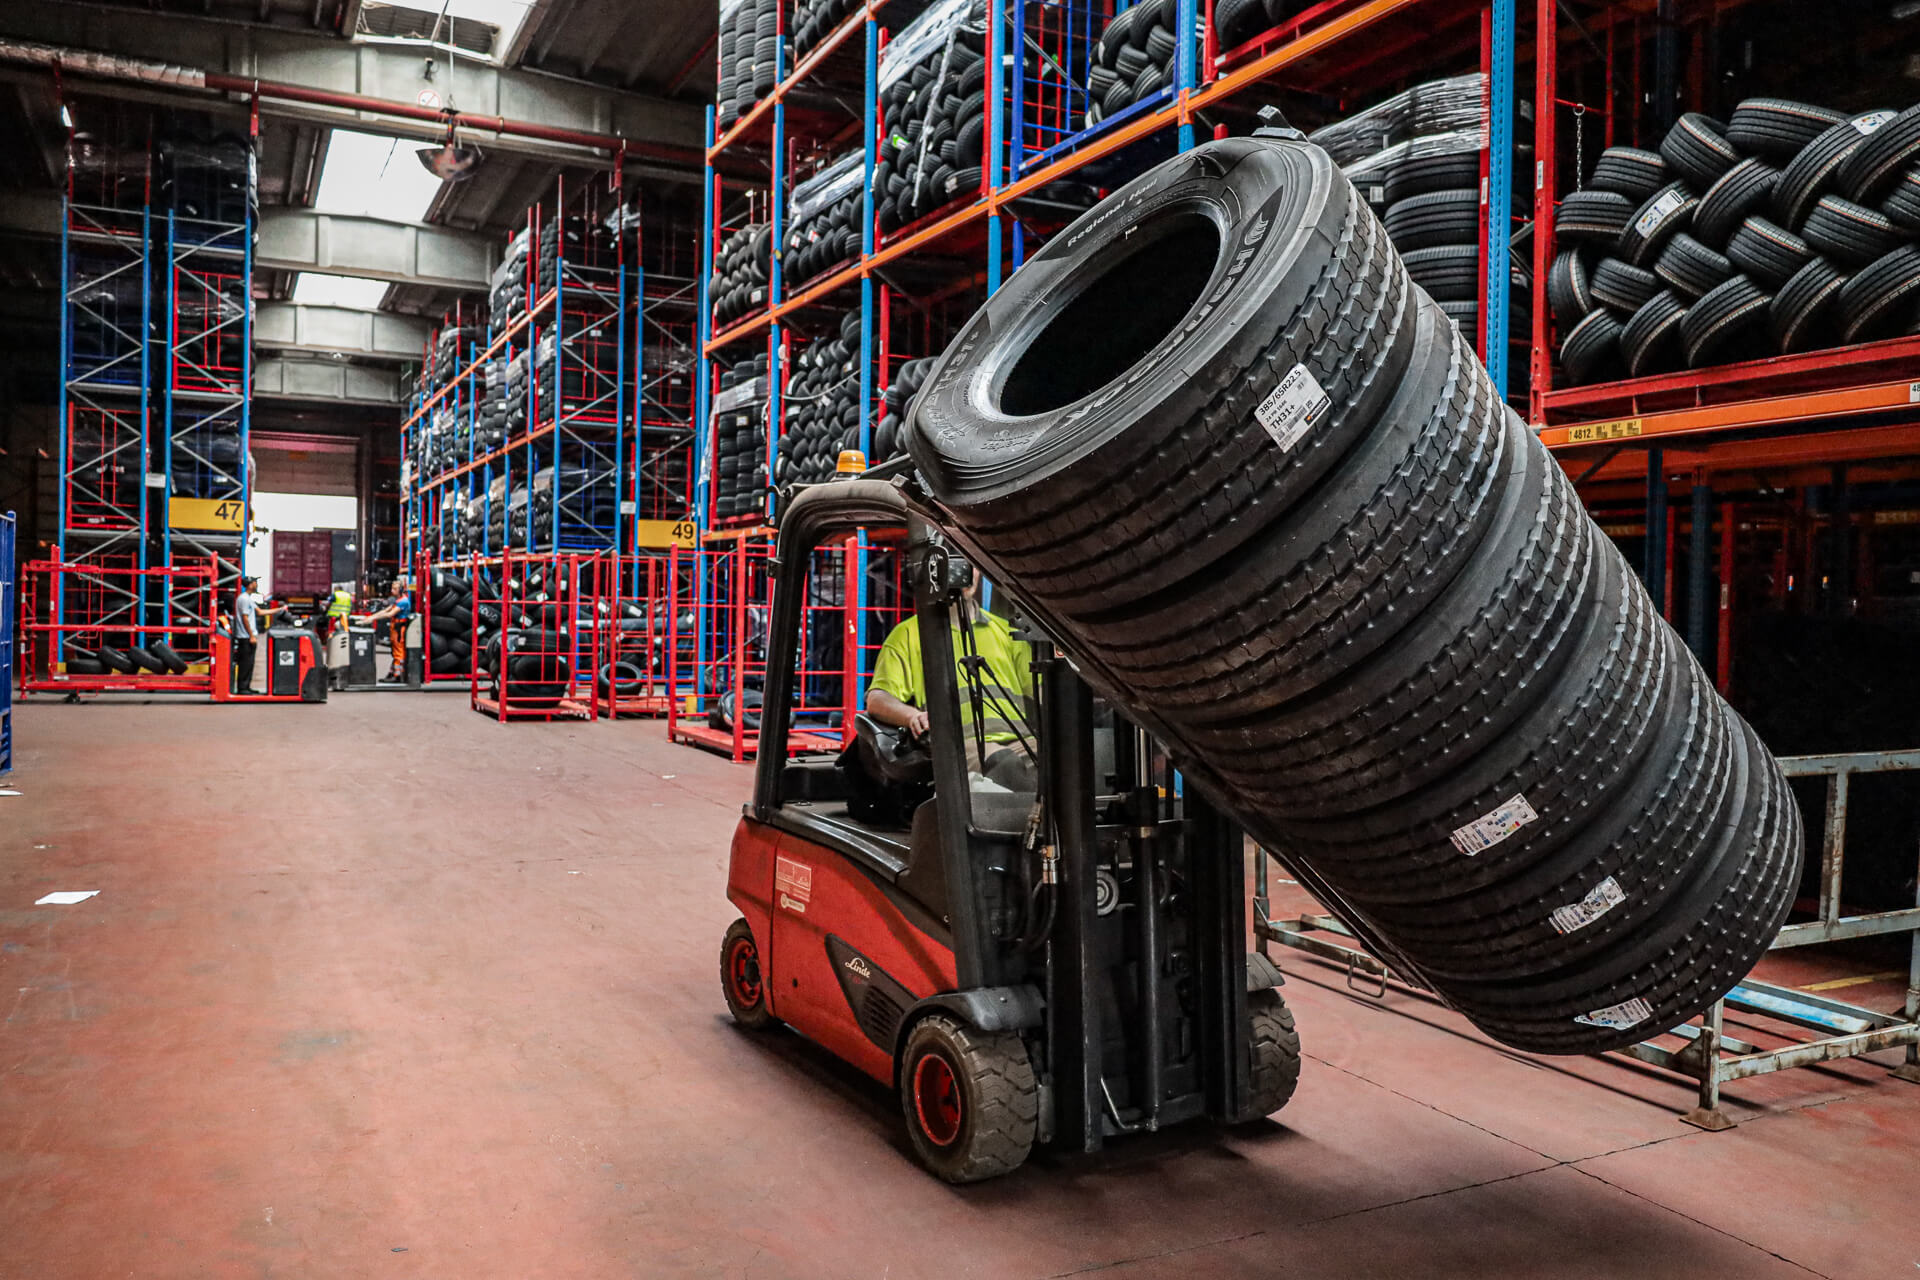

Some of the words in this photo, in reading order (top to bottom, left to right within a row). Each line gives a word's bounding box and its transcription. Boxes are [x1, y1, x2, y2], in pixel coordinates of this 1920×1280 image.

[1259, 369, 1302, 416] 385/65R22.5
[1270, 404, 1295, 429] TH31+
[214, 502, 242, 520] 47
[672, 522, 694, 540] 49
[844, 957, 870, 979] Linde
